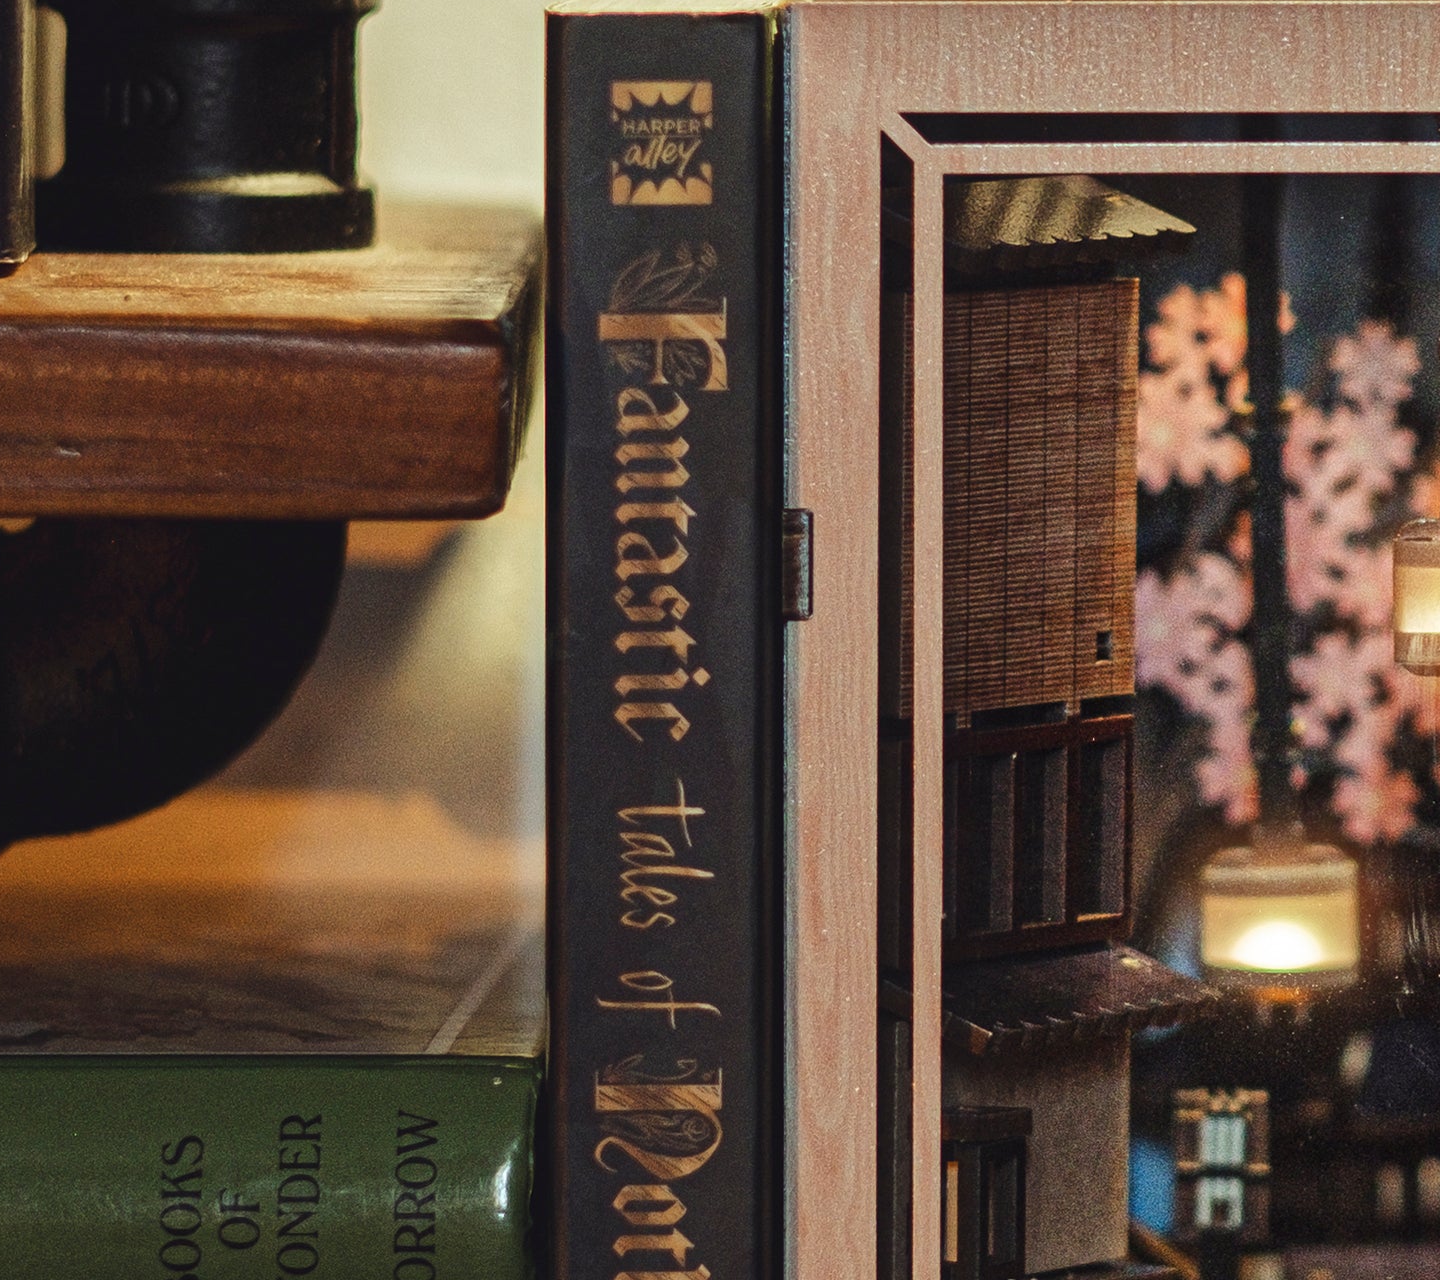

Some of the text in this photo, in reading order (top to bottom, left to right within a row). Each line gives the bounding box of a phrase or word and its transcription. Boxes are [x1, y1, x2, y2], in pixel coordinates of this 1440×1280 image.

[622, 119, 700, 135] HARPER
[624, 134, 702, 174] alley
[597, 294, 730, 744] Fantastic
[618, 779, 715, 928] tales
[596, 970, 722, 1029] of
[218, 1188, 261, 1251] OF
